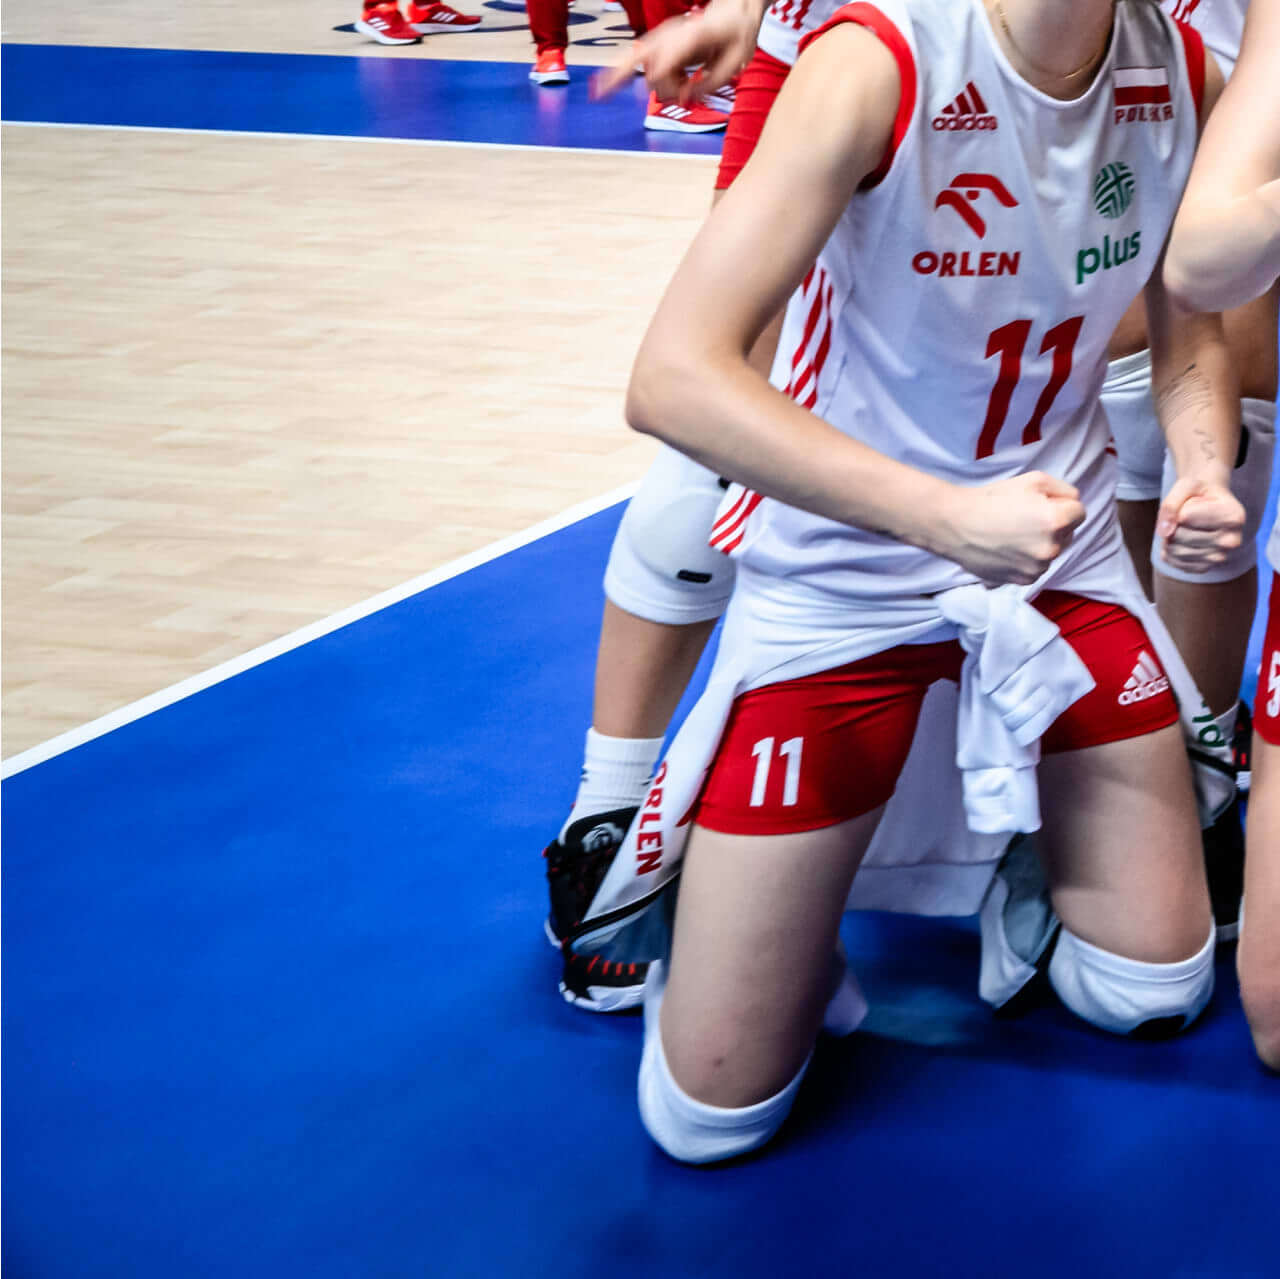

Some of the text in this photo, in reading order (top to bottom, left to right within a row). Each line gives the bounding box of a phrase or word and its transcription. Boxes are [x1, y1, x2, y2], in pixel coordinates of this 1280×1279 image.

[931, 113, 999, 133] adidas
[1113, 103, 1175, 126] POLKA
[911, 250, 1022, 278] ORLEN
[1075, 229, 1143, 285] plus
[975, 314, 1086, 462] 11
[747, 736, 806, 809] 11
